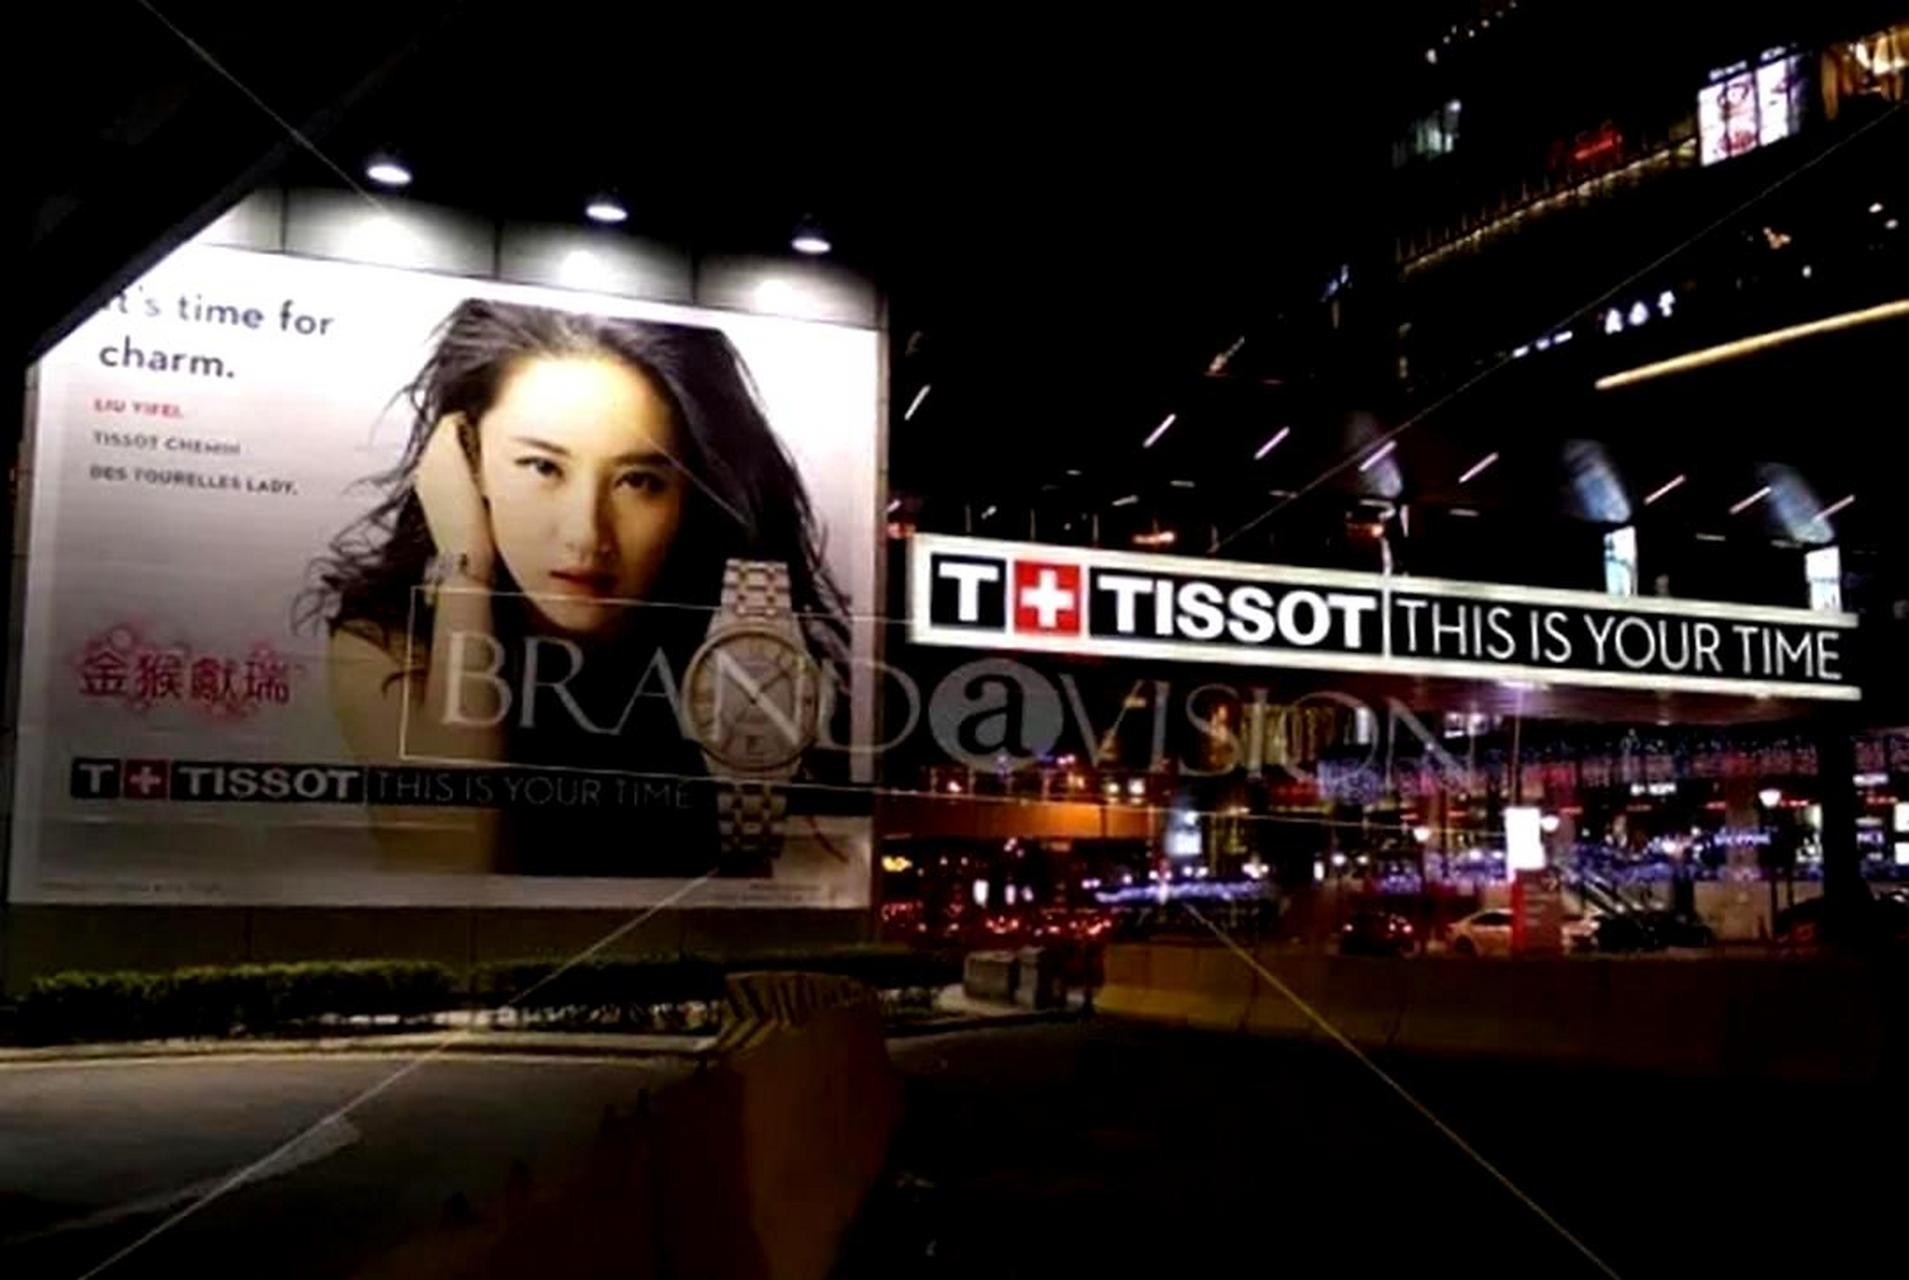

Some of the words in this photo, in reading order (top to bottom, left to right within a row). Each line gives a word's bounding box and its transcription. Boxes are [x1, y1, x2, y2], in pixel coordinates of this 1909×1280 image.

[178, 294, 264, 329] time
[280, 299, 335, 336] for
[98, 334, 236, 379] charm.
[94, 430, 159, 449] TISSOT
[134, 467, 241, 490] TOURELLES
[938, 562, 1000, 622] T
[1096, 574, 1377, 649] TISSOT
[1395, 599, 1517, 660] THIS
[1529, 611, 1574, 664] IS
[1583, 614, 1723, 673] YOUR
[1732, 626, 1842, 680] TIME
[79, 764, 114, 792] T
[177, 768, 360, 799] TISSOT
[375, 770, 455, 802] THIS
[464, 774, 494, 801] IS
[502, 776, 602, 806] YOUR
[615, 777, 694, 810] TIME
